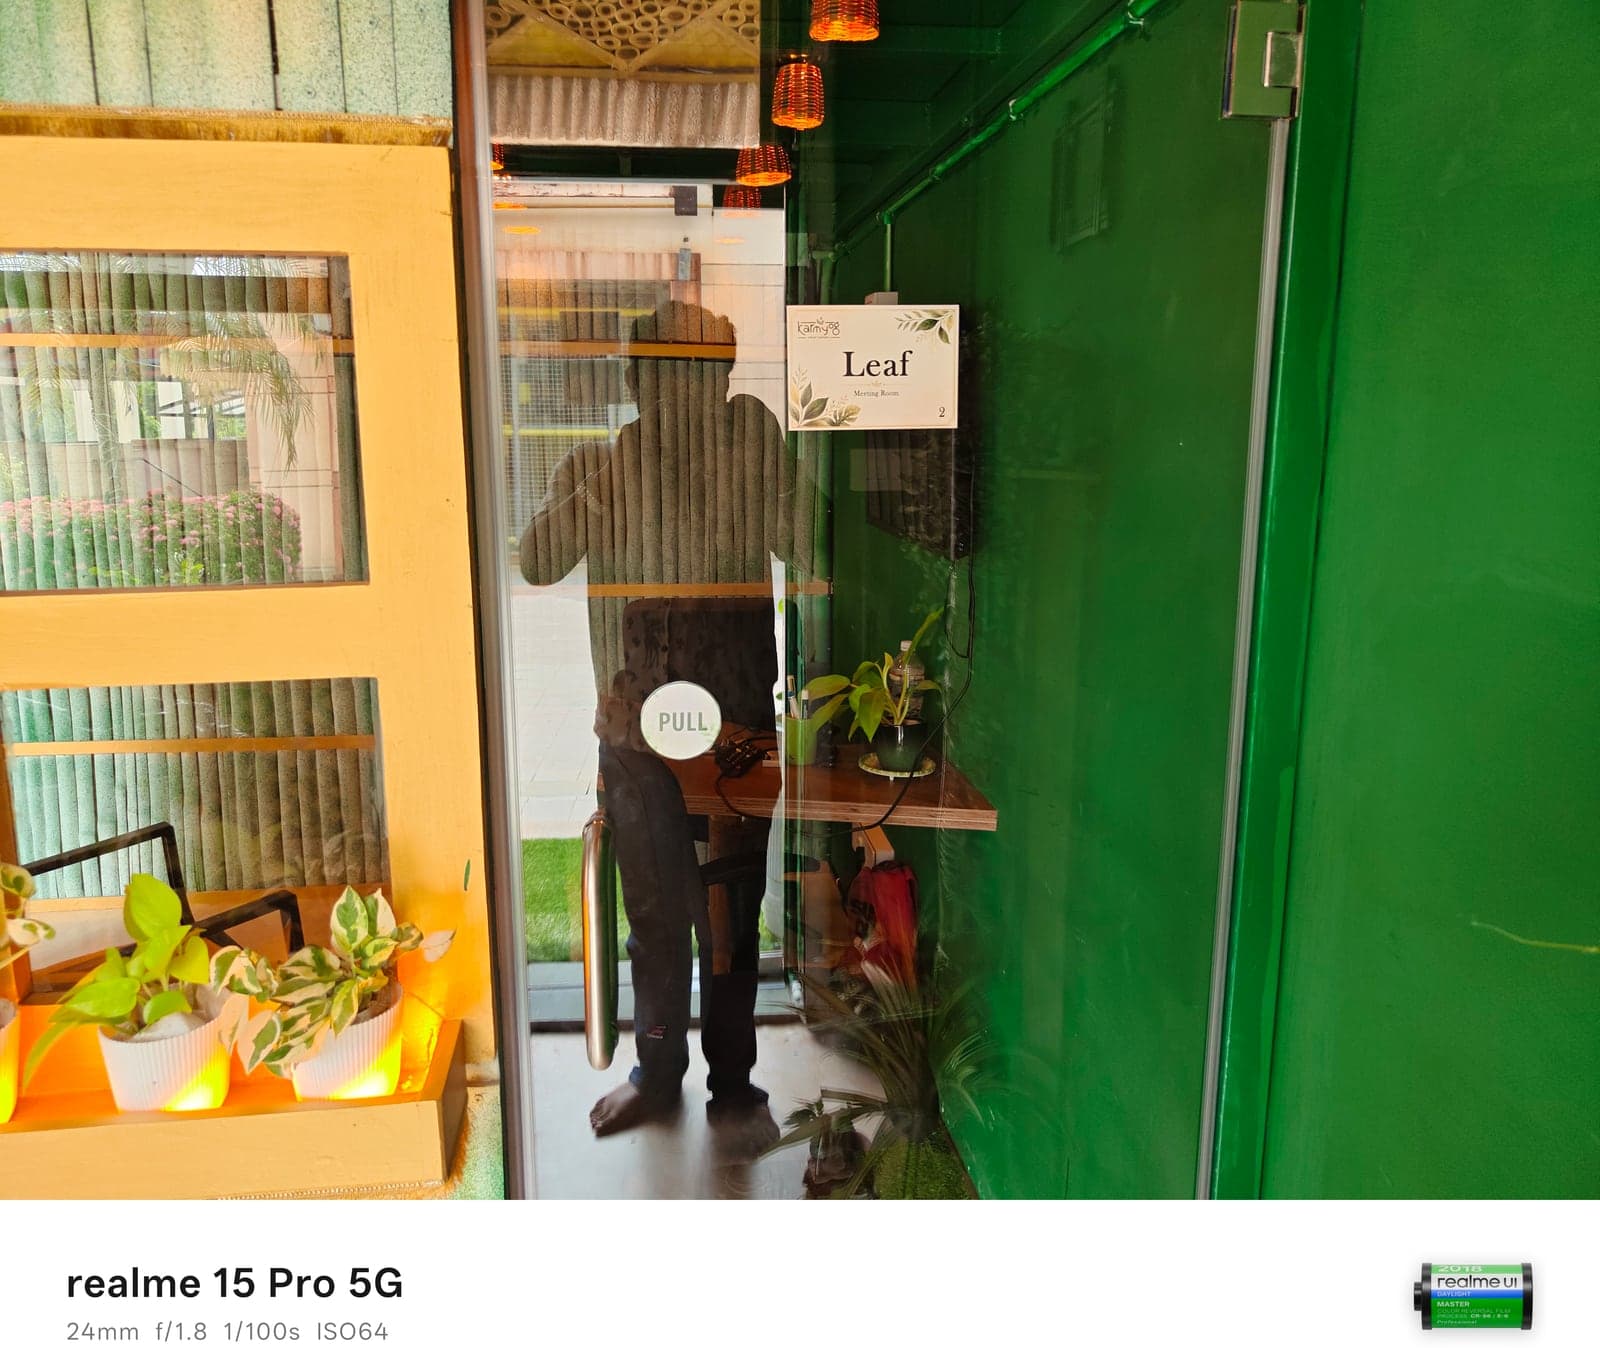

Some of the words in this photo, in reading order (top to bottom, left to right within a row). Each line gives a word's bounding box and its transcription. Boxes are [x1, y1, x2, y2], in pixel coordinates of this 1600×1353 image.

[842, 350, 913, 377] Leaf
[853, 389, 879, 398] Meeting
[880, 389, 900, 397] Room
[938, 406, 946, 418] 2
[659, 711, 708, 732] PULL
